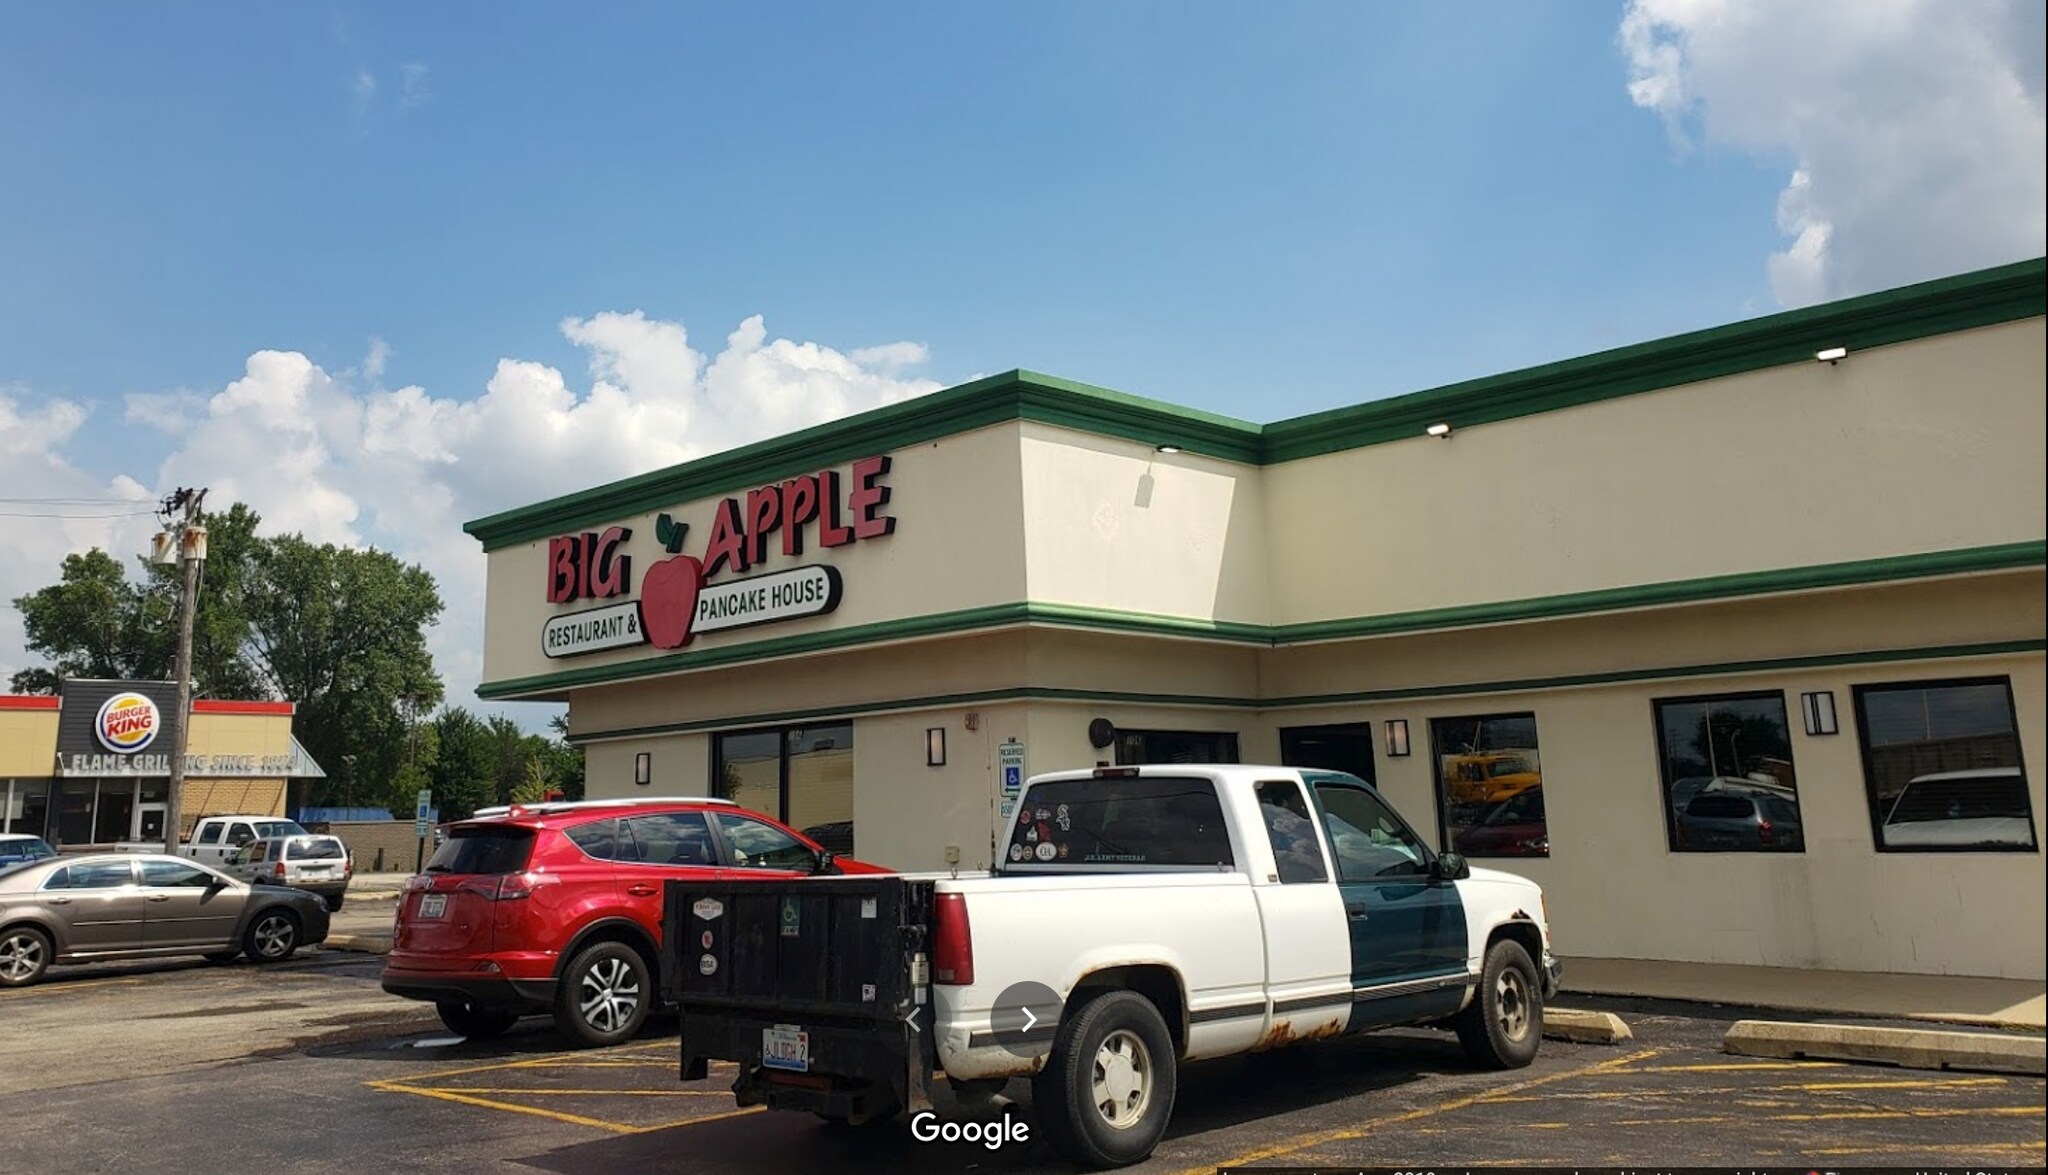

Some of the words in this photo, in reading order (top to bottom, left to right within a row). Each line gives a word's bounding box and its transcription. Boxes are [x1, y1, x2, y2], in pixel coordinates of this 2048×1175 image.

[547, 526, 633, 603] BIG
[701, 455, 897, 578] APPLE
[548, 615, 623, 648] RESTAURANT
[627, 614, 637, 634] &
[699, 588, 766, 621] PANCAKE
[772, 576, 824, 609] HOUSE
[106, 706, 151, 724] BURGER
[107, 715, 152, 738] KING
[1000, 748, 1023, 756] RESERVED
[1002, 757, 1022, 765] PARKING
[72, 754, 126, 772] FLAME
[132, 754, 207, 771] GRILNG
[209, 754, 256, 771] SINCE
